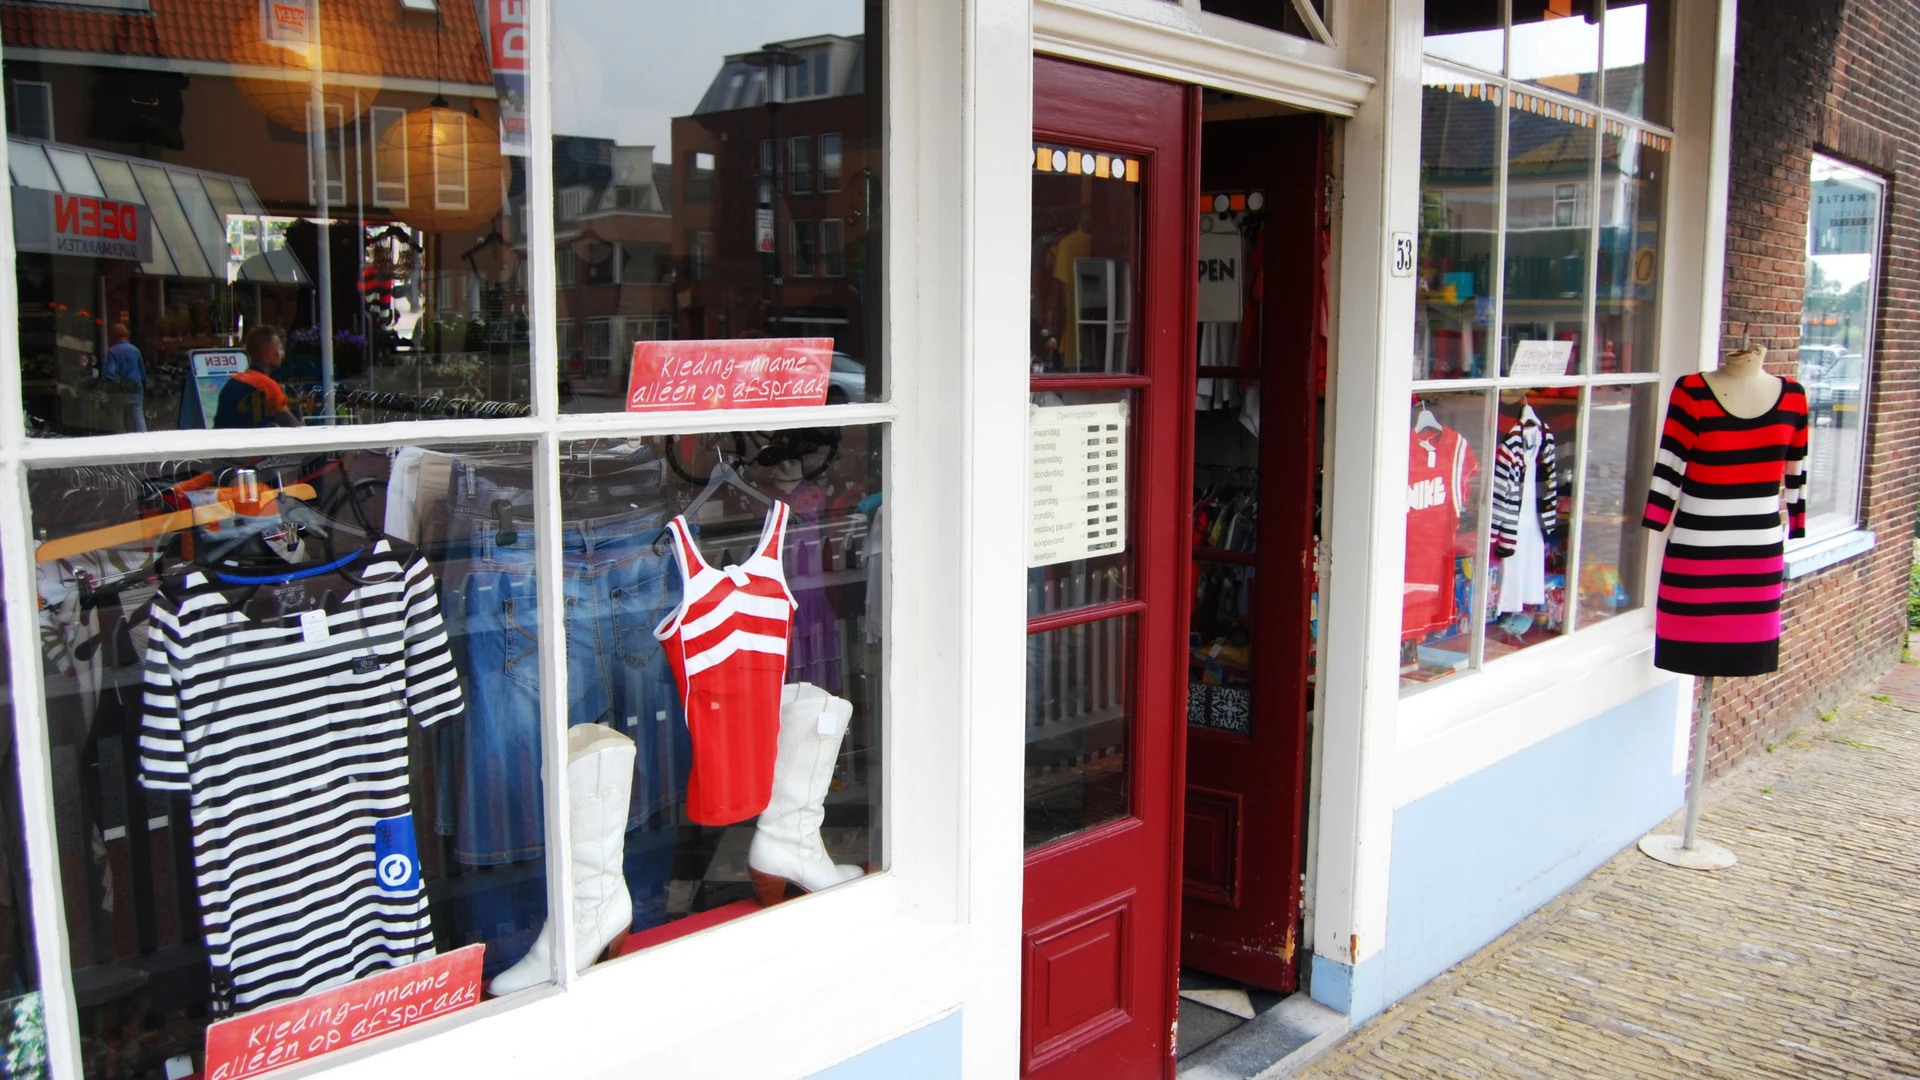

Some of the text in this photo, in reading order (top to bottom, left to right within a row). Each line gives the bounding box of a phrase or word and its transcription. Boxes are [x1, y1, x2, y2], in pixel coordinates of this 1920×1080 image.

[1396, 239, 1412, 270] 53
[1198, 258, 1235, 282] PEN
[660, 353, 807, 380] Kleding-inname
[702, 383, 726, 403] op
[732, 375, 826, 401] afspraak
[1033, 428, 1061, 437] maandag
[1033, 442, 1056, 451] dinsdag
[1033, 456, 1063, 465] woensdag
[1033, 469, 1064, 479] donderdag
[1033, 484, 1052, 493] vrijdag
[1033, 497, 1059, 507] zaterdag
[1033, 511, 1055, 520] zondag
[1033, 522, 1073, 534] middag pauze
[1033, 536, 1065, 548] koopavond
[248, 970, 450, 1049] Kleding-inname
[308, 1028, 341, 1052] op
[351, 981, 478, 1038] afspraak
